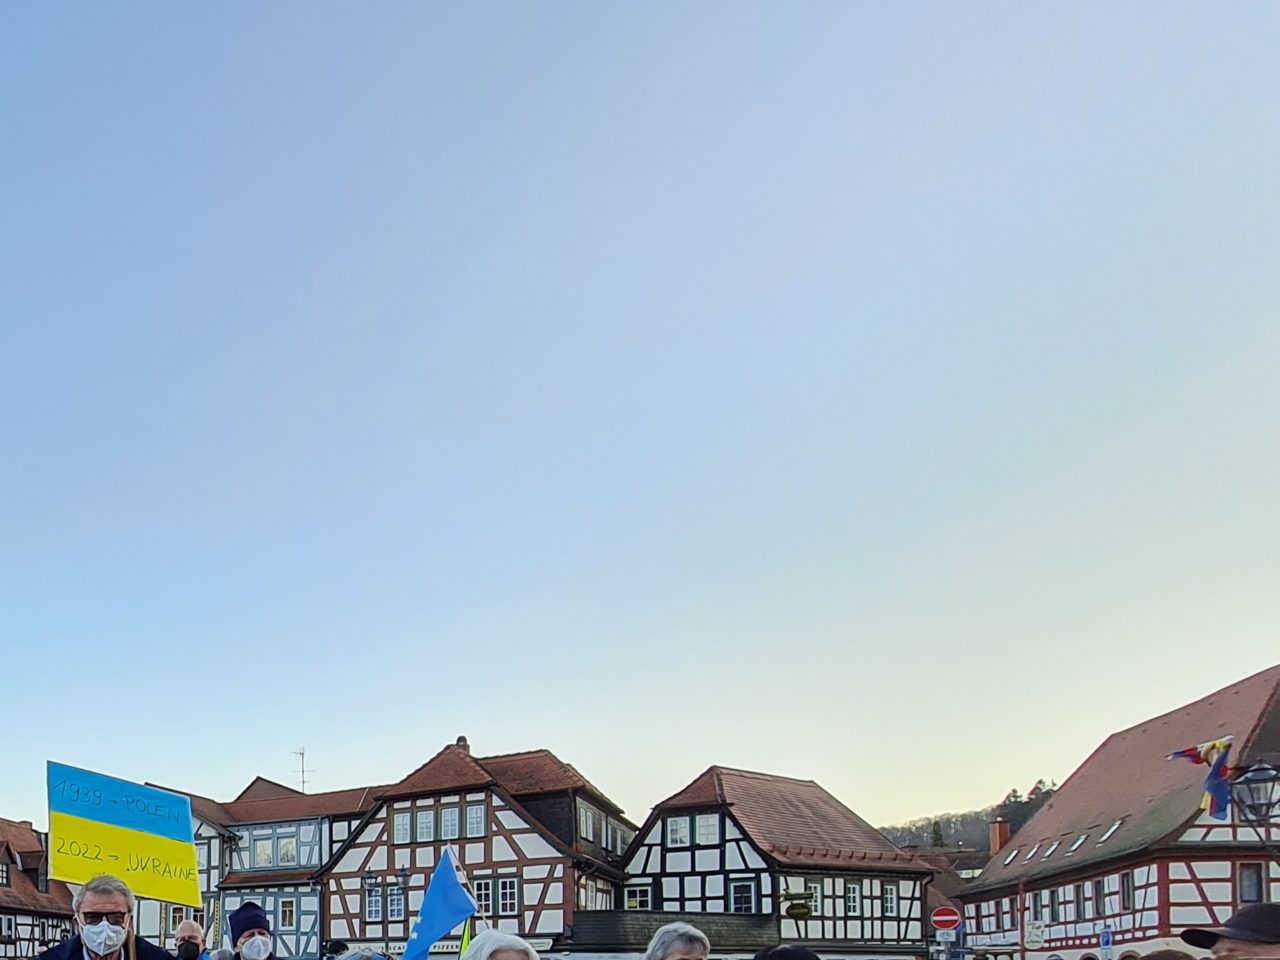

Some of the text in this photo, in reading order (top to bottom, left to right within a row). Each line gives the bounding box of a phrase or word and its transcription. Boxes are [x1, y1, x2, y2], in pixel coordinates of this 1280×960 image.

[54, 779, 102, 806] 1939
[121, 794, 180, 824] POLEN
[57, 837, 104, 861] 2022
